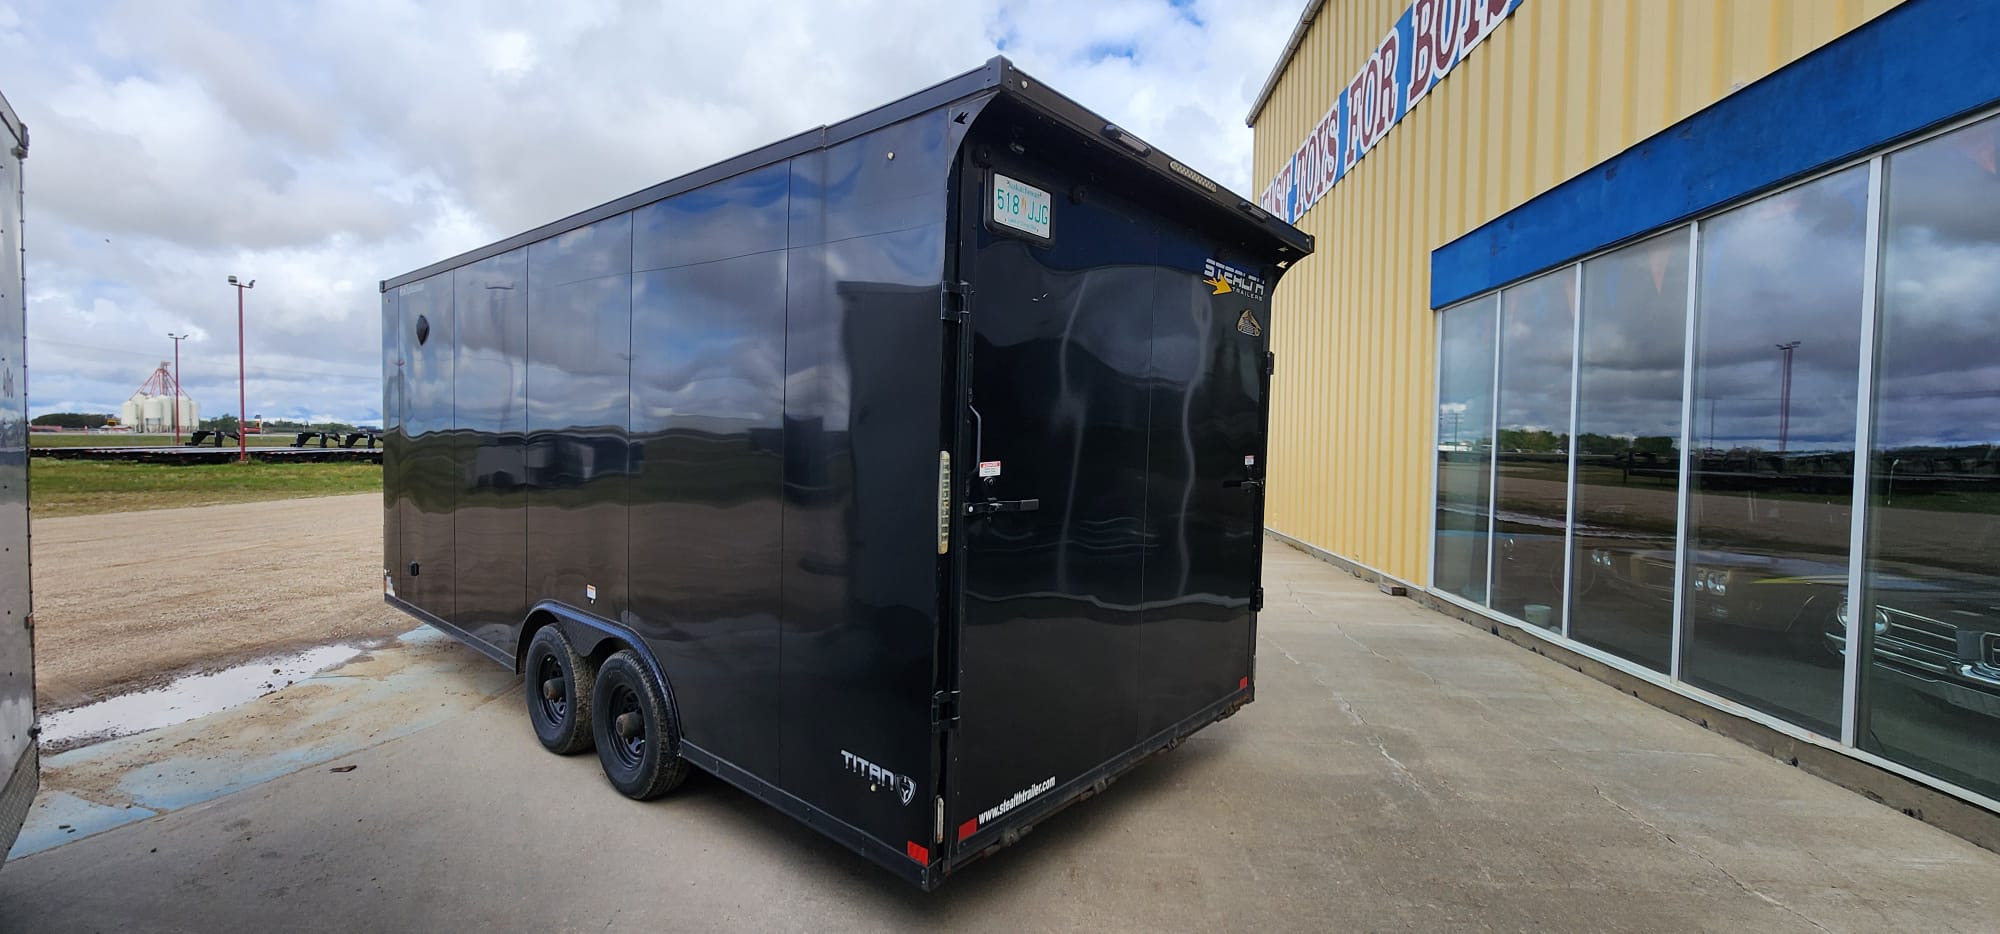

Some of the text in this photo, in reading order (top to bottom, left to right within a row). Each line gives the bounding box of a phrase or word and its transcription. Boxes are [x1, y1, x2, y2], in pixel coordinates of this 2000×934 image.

[1295, 103, 1339, 218] TOYS
[1344, 28, 1399, 168] FOR
[1407, 0, 1510, 106] BO
[996, 188, 1020, 215] 518
[1027, 199, 1049, 225] JJG
[1203, 258, 1265, 296] STEALTH
[1231, 286, 1263, 302] TRAILERS
[840, 749, 895, 791] TITAN
[978, 776, 1056, 825] www.stealthtrailer.com
